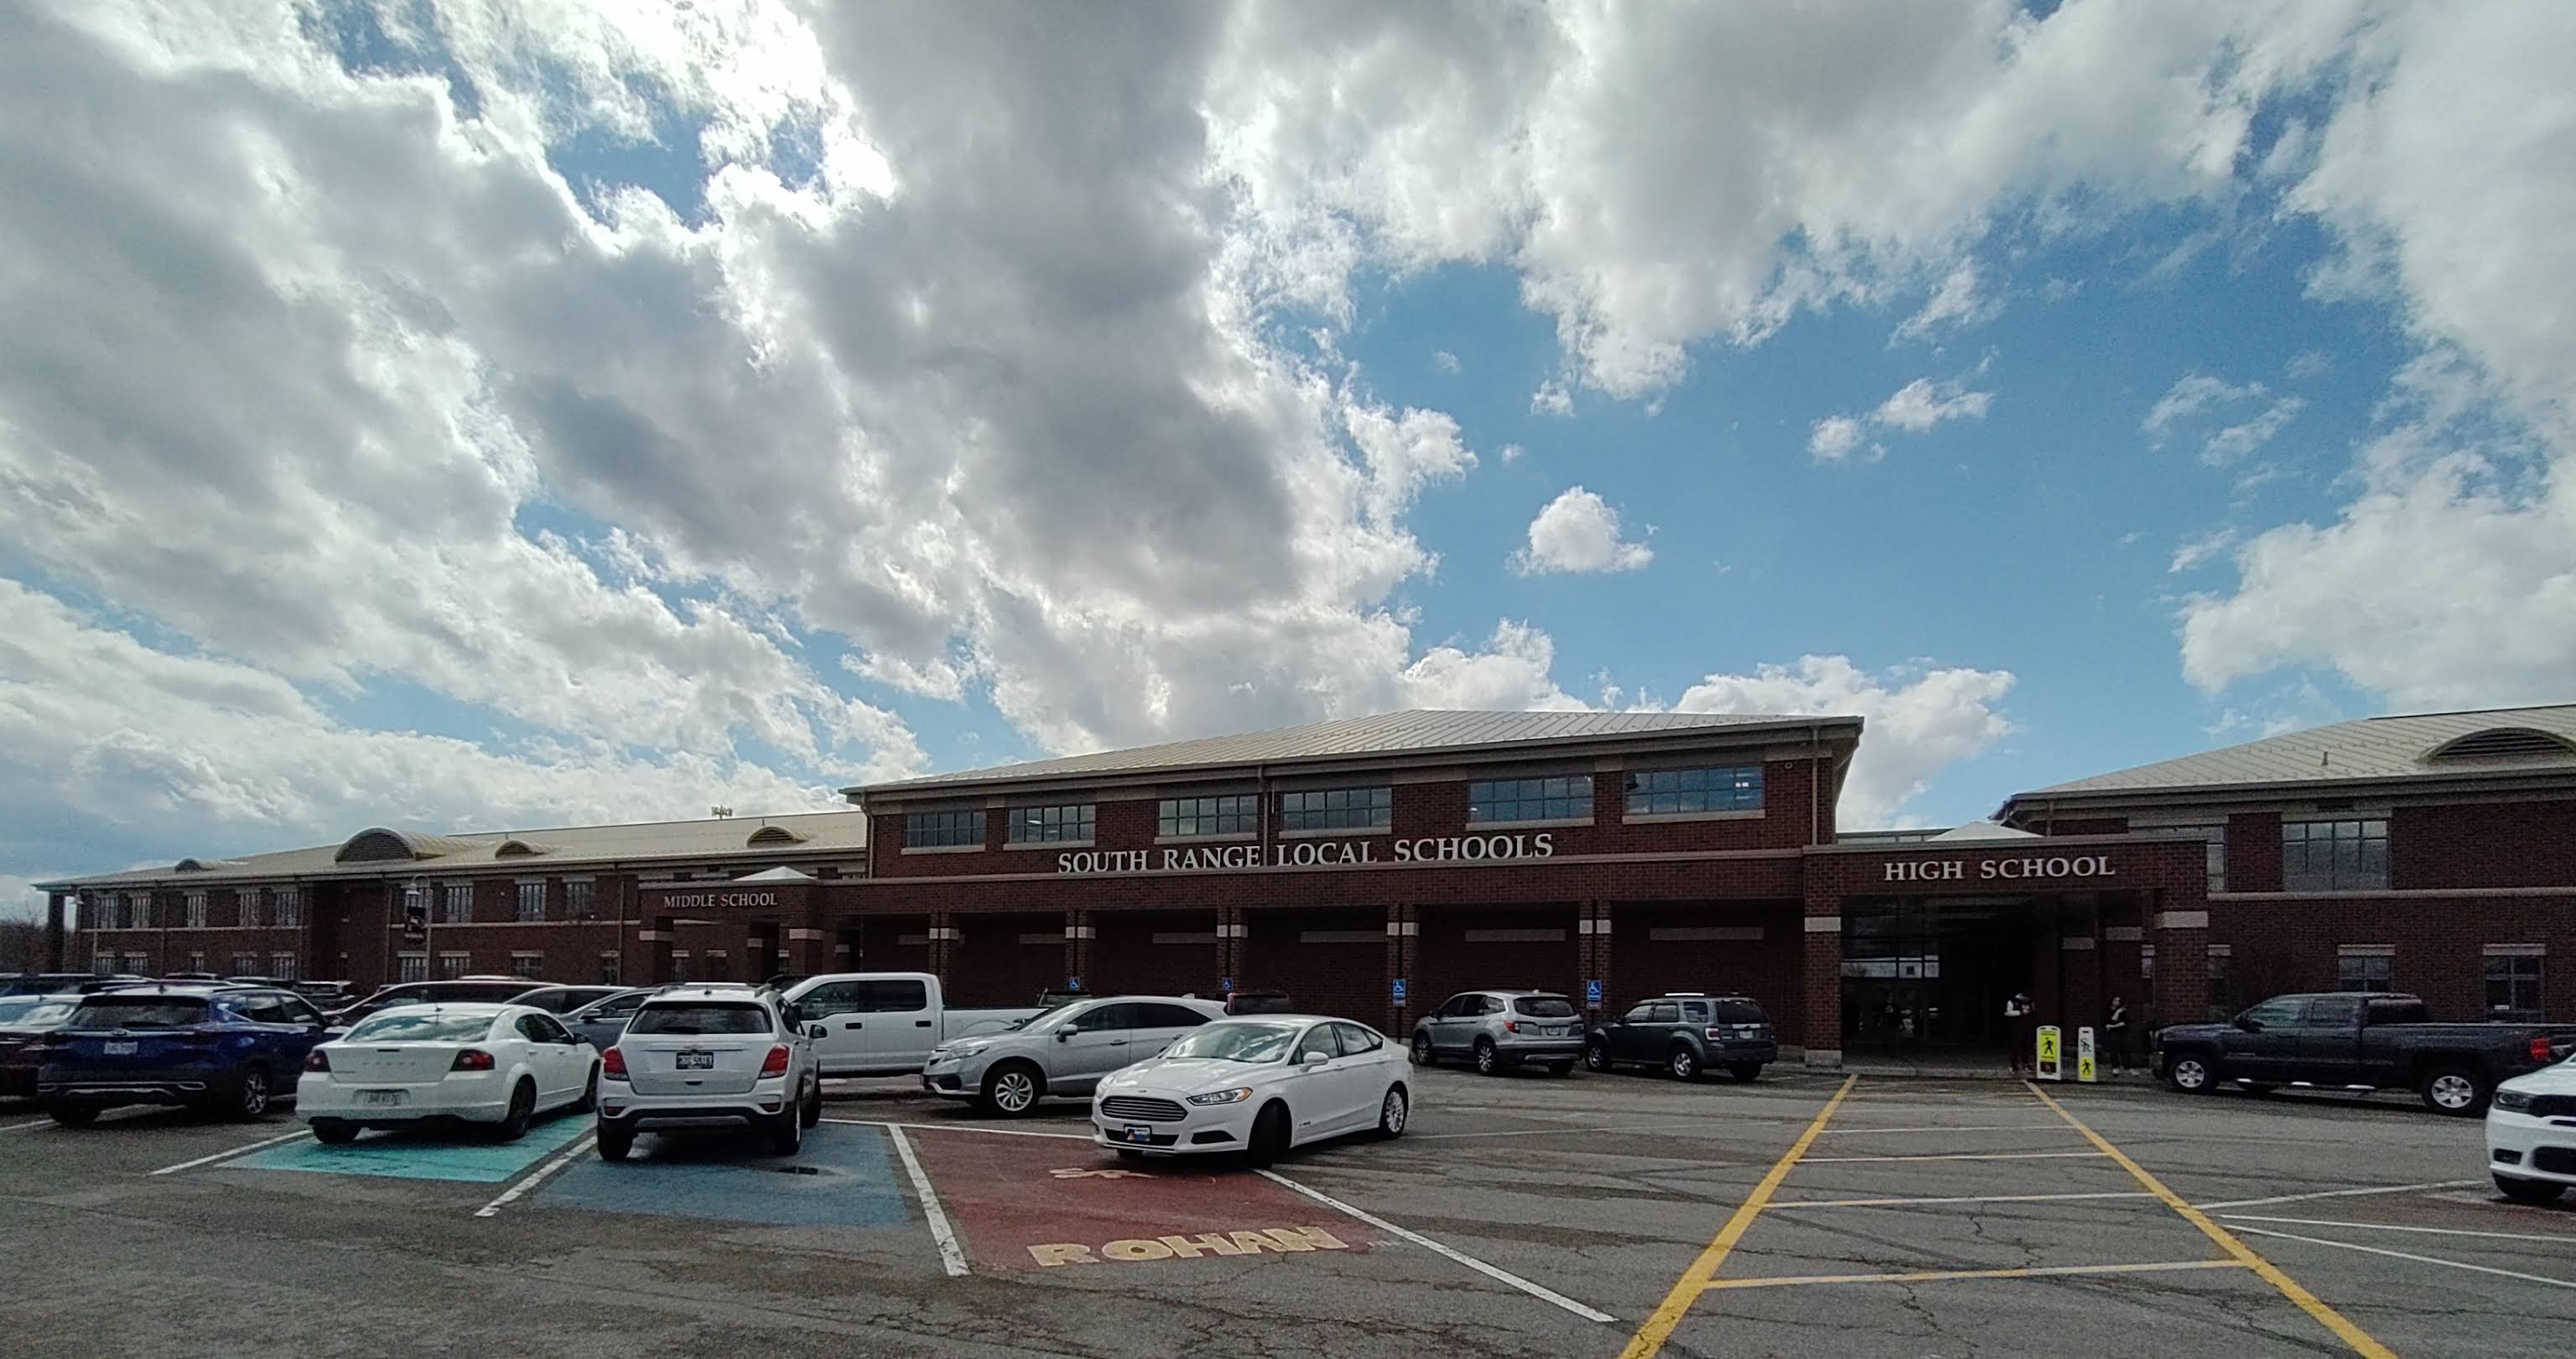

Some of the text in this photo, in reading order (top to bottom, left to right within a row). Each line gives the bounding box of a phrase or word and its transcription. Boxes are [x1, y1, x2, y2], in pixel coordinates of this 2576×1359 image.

[1058, 833, 1553, 873] SOUTH RANGE LOCAL SCHOOLS
[1883, 856, 2116, 880] HIGH SCHOOL
[663, 893, 777, 908] MIDDLE SCHOOL
[1026, 1227, 1349, 1267] ROHAN
